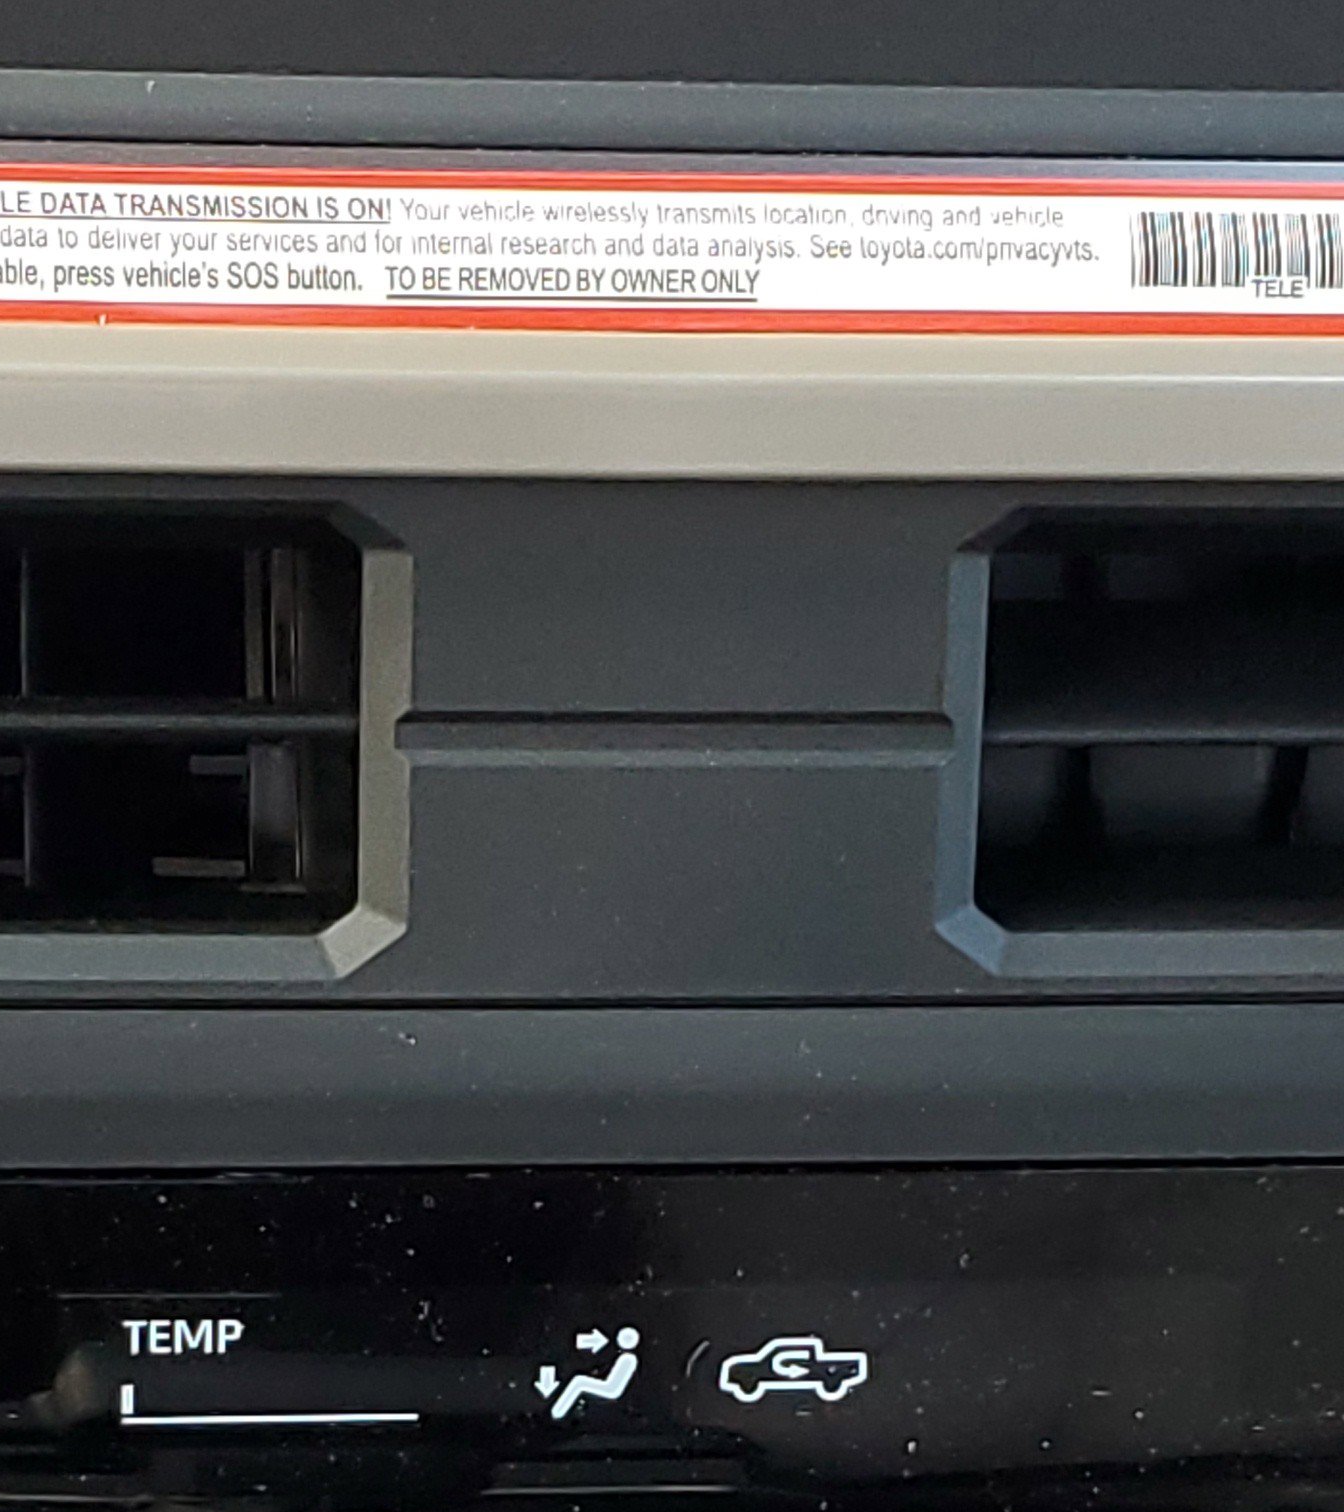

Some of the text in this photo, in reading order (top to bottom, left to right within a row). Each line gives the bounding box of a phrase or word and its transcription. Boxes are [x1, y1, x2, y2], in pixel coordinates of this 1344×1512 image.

[42, 192, 106, 216] DATA
[114, 193, 308, 219] TRANSMISSION
[317, 196, 340, 219] IS
[348, 197, 391, 221] ON!
[401, 198, 449, 221] Your
[459, 199, 535, 222] vehicle
[543, 202, 649, 226] wirelessly
[657, 204, 756, 225] transmits
[943, 206, 981, 226] and
[991, 207, 1064, 228] vehicle
[0, 223, 48, 247] data
[58, 226, 78, 248] to
[88, 226, 161, 251] deliver
[170, 232, 217, 257] your
[226, 230, 318, 253] services
[327, 231, 366, 253] and
[375, 231, 402, 253] for
[412, 232, 492, 255] internal
[501, 233, 596, 256] research
[605, 234, 644, 257] and
[653, 235, 699, 258] data
[708, 235, 800, 264] analysis.
[810, 236, 851, 259] See
[53, 265, 114, 292] press
[123, 260, 219, 288] vehicle's
[227, 261, 279, 290] SOS
[287, 264, 363, 291] button.
[385, 266, 415, 290] TO
[422, 267, 452, 291] BE
[459, 267, 570, 292] REMOVED
[577, 269, 605, 293] BY
[611, 268, 696, 293] OWNER
[702, 269, 759, 294] ONLY
[1252, 279, 1304, 299] TELE
[123, 1318, 245, 1355] TEMP
